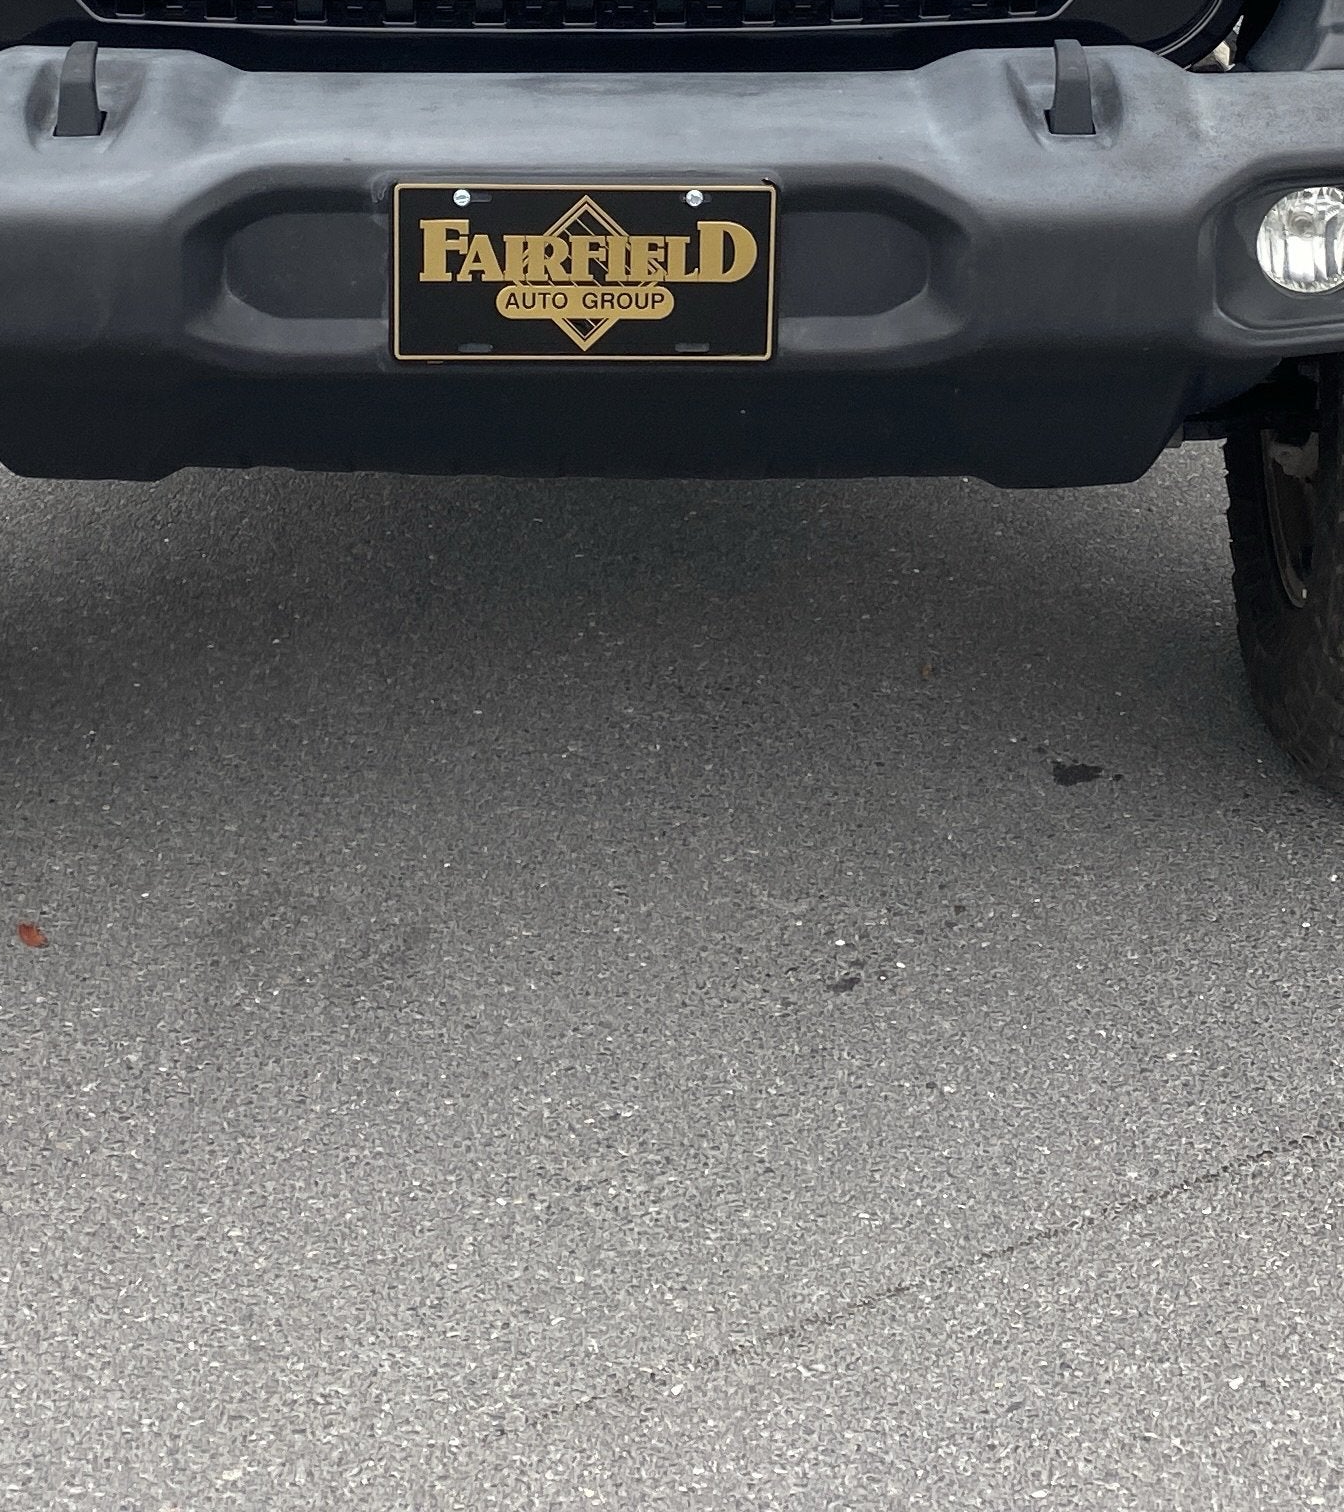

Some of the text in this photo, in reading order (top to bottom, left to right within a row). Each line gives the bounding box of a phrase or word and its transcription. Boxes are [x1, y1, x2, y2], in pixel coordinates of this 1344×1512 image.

[419, 219, 758, 283] FAIRFIELD
[505, 292, 665, 310] AUTO GROUP
